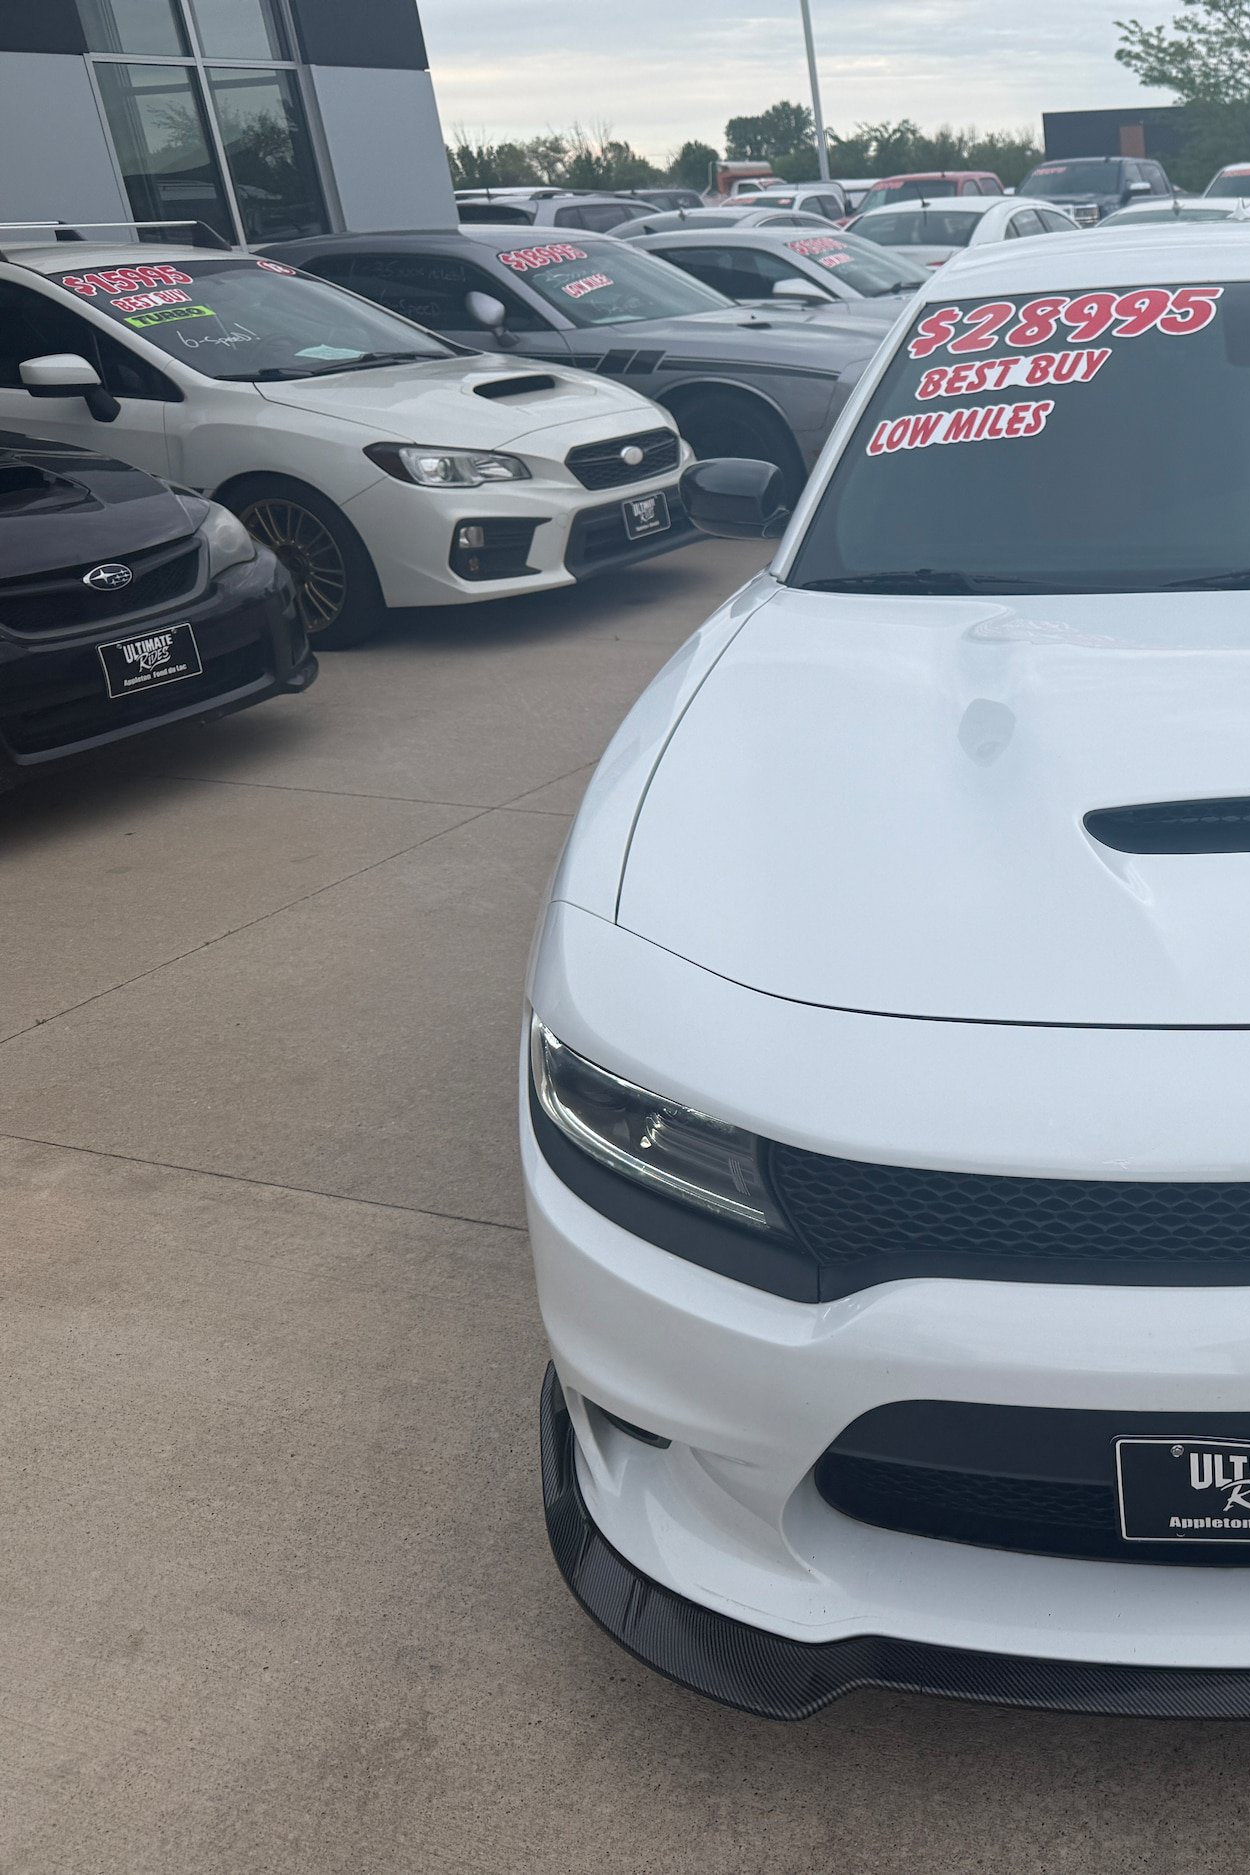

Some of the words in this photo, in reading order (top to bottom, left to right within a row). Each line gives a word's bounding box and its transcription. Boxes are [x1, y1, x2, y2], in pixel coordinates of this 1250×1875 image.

[62, 265, 193, 297] $15995
[110, 292, 158, 314] BEST
[157, 288, 193, 308] BUY
[130, 306, 206, 325] TURBO
[908, 287, 1224, 359] $28995
[915, 358, 1022, 400] BEST
[1024, 348, 1112, 386] BUY
[866, 413, 944, 456] LOW
[942, 400, 1055, 442] MILES
[123, 634, 173, 664] ULTIMATE
